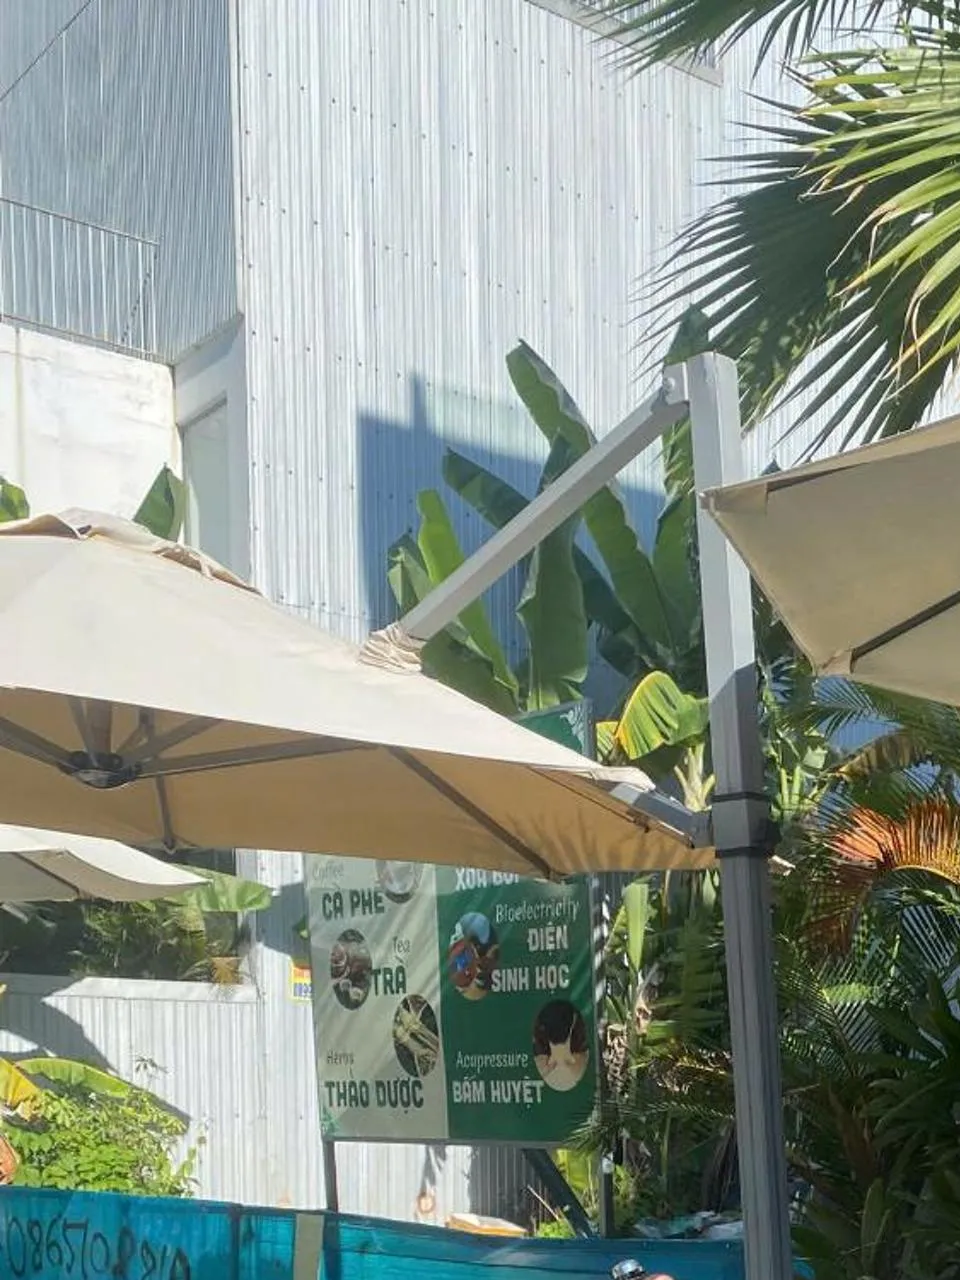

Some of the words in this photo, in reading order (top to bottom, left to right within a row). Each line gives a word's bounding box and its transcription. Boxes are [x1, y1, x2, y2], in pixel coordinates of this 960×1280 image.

[495, 895, 580, 924] Bioelectricity
[527, 921, 569, 956] ĐIỆN
[371, 955, 407, 997] TRÀ
[490, 966, 530, 993] SINH
[535, 963, 570, 995] HỌC
[455, 1050, 529, 1074] Acupressure
[375, 1078, 424, 1114] DƯỢC
[452, 1073, 486, 1104] BẤM
[490, 1075, 545, 1109] HUYỆT
